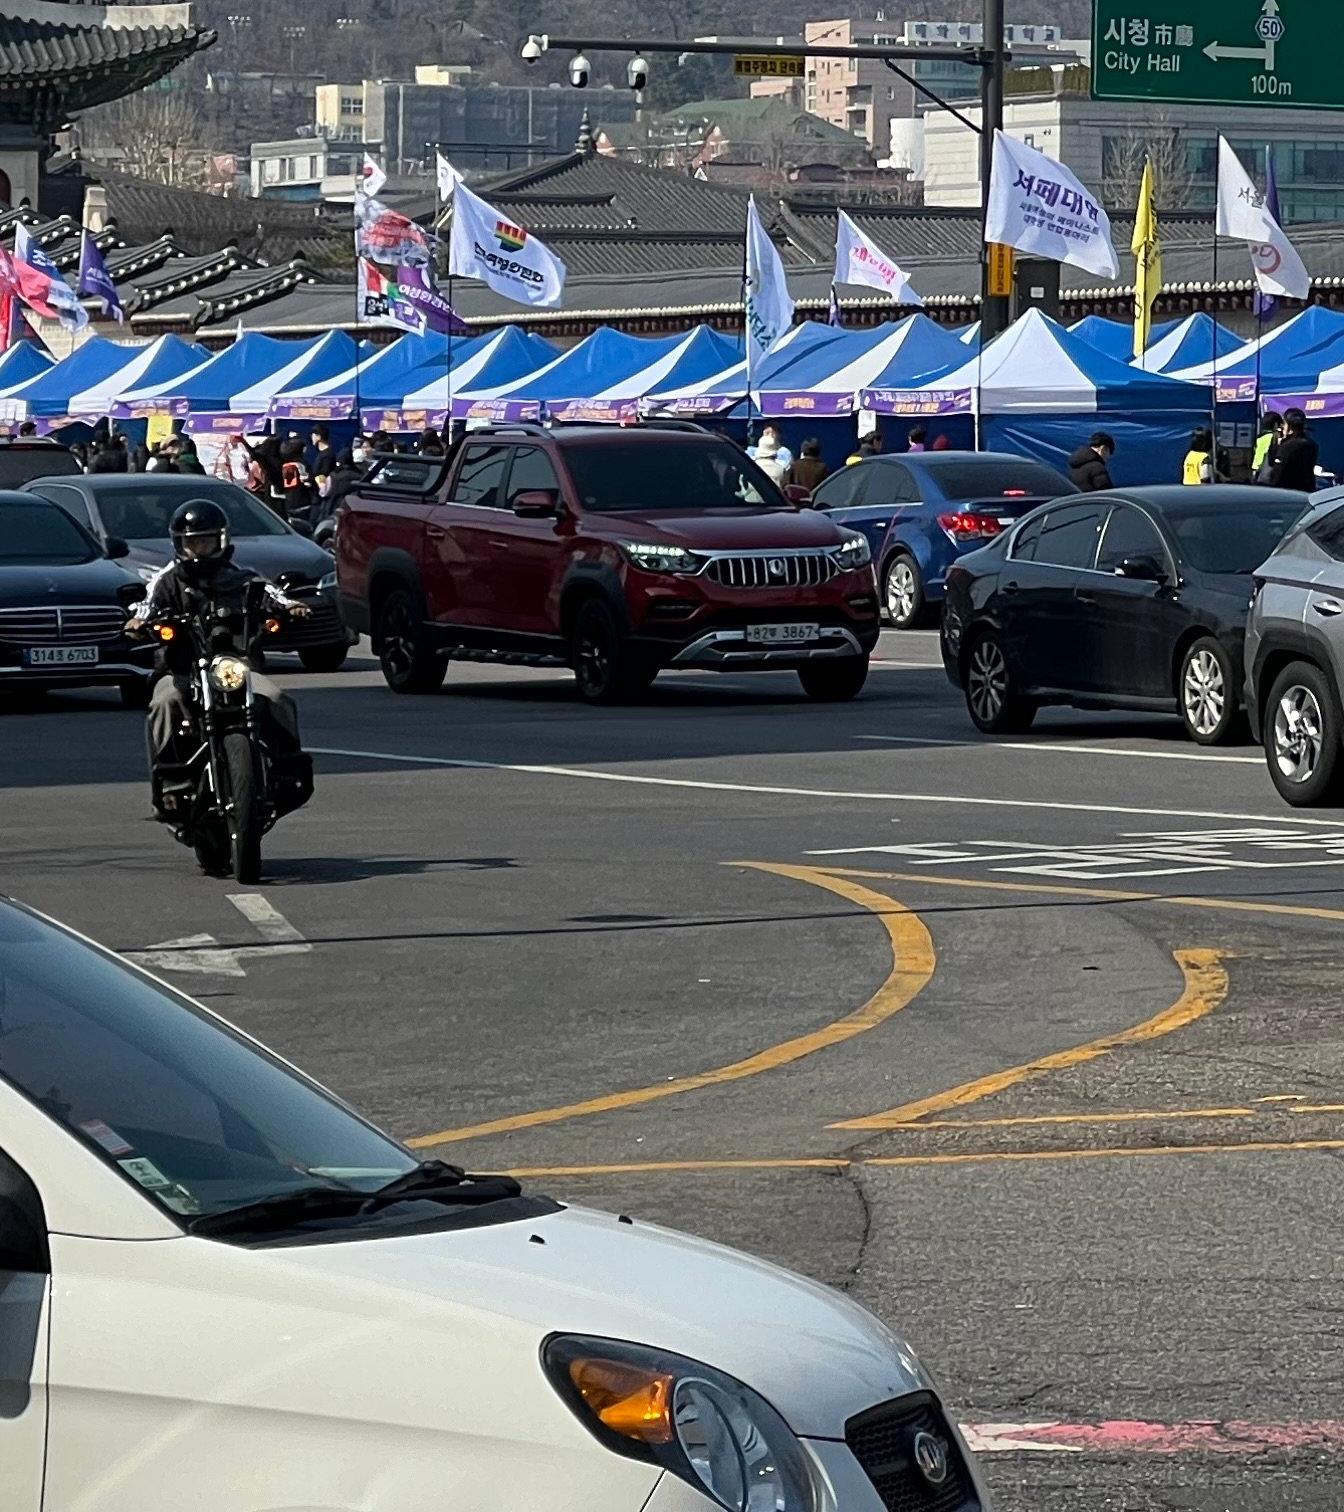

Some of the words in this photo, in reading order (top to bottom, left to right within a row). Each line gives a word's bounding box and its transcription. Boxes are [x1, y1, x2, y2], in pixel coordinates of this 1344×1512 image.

[1104, 17, 1150, 47] 시청
[1261, 21, 1279, 37] 50
[1104, 51, 1140, 72] City
[1147, 52, 1181, 73] Hall
[1251, 76, 1293, 96] 100m
